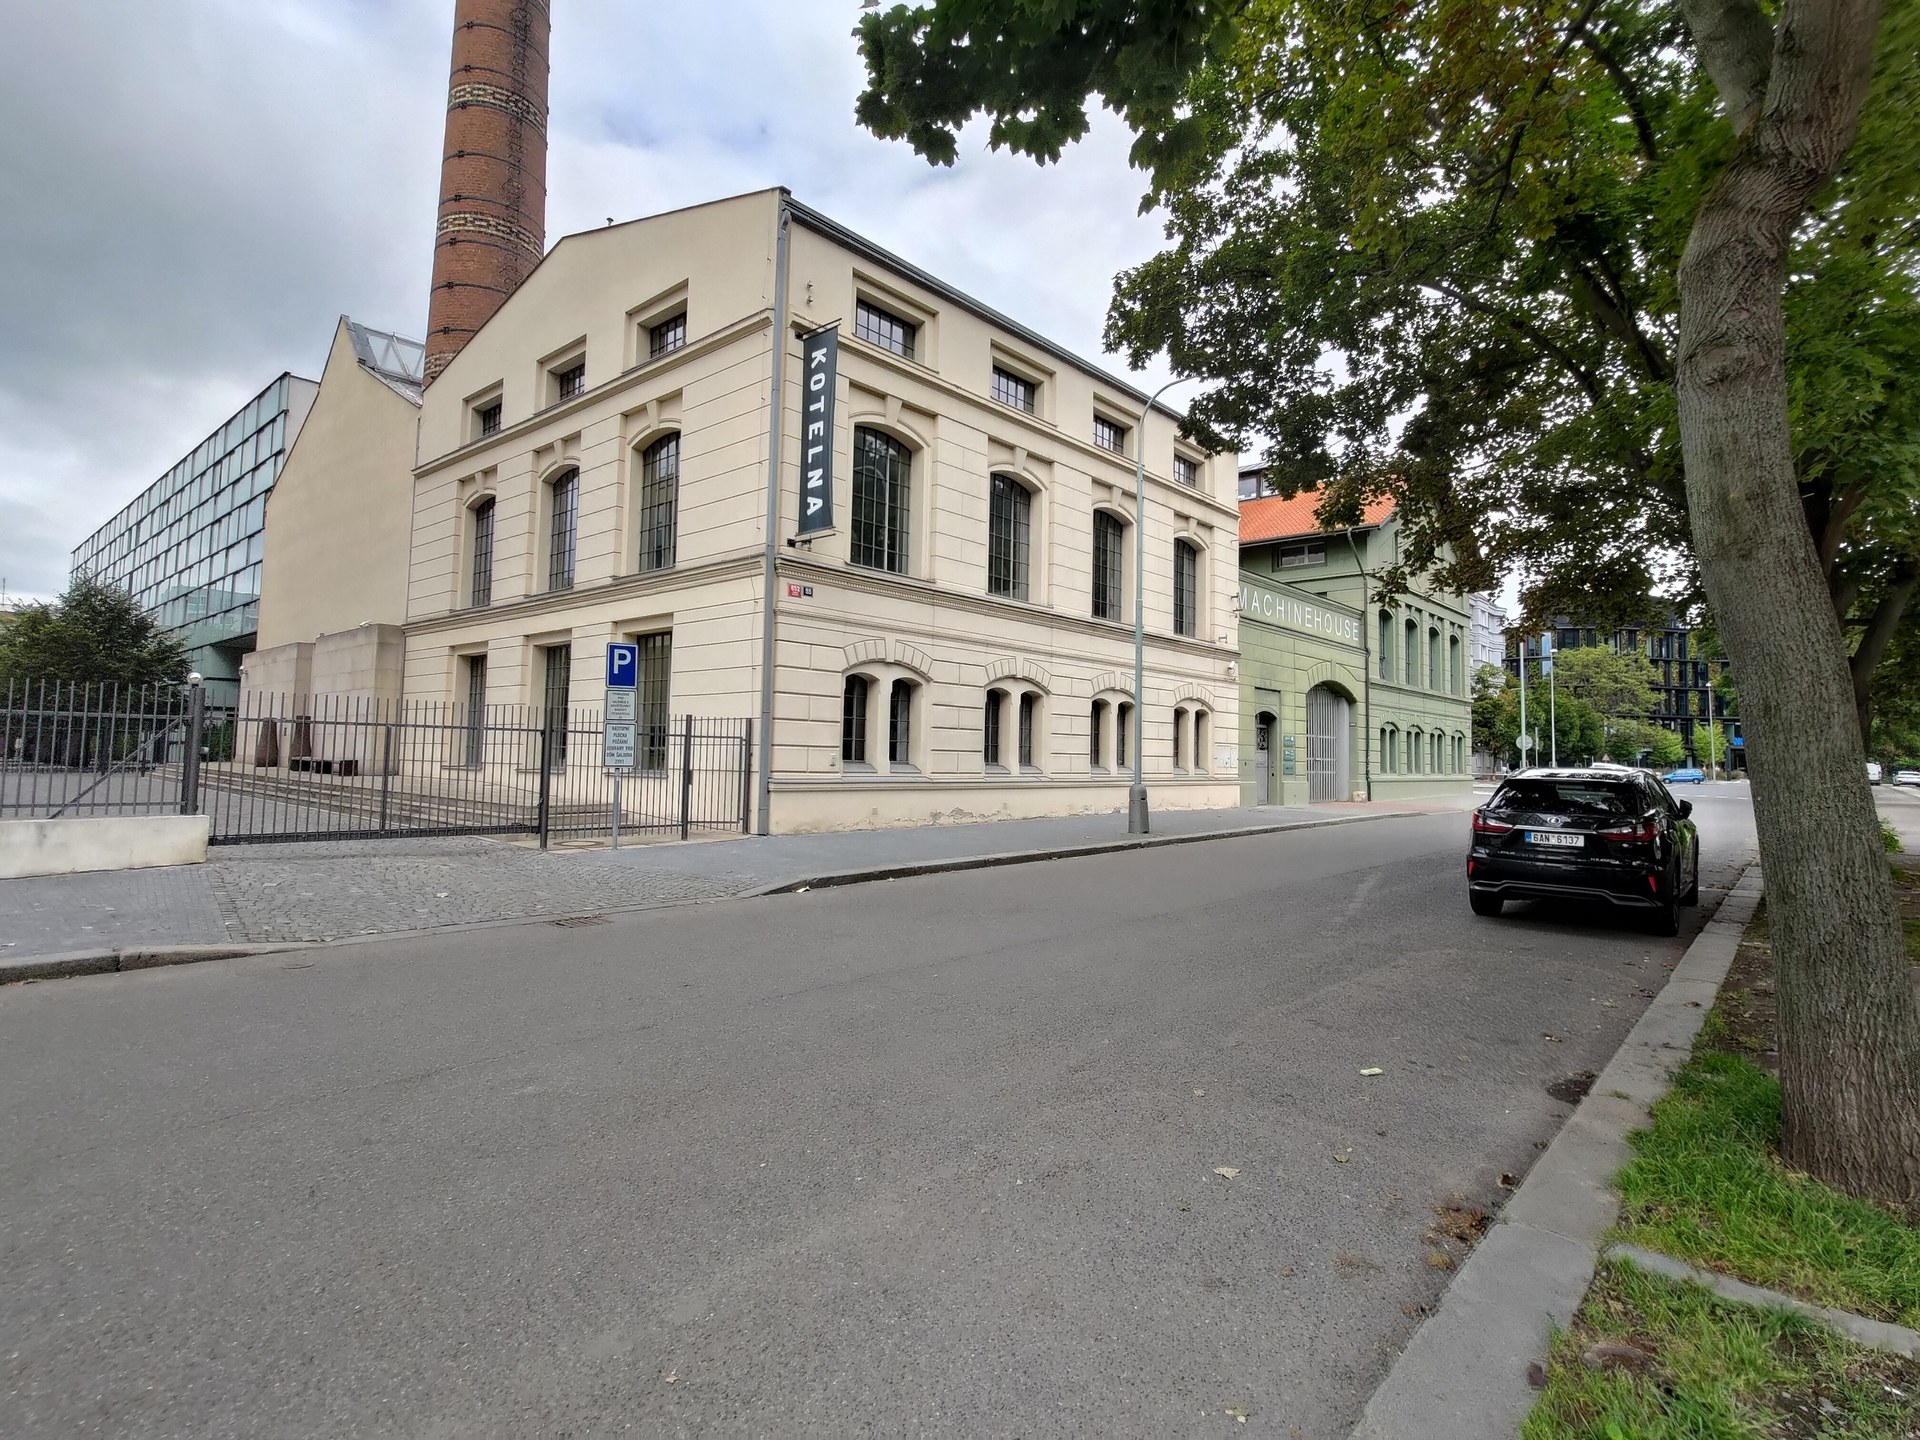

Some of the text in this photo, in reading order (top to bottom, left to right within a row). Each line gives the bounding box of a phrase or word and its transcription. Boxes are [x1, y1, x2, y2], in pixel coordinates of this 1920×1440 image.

[806, 347, 828, 516] KOTELNA
[1238, 586, 1360, 642] MACHINEHOUSE
[613, 648, 632, 674] P
[1533, 833, 1580, 845] 6AN 6137
